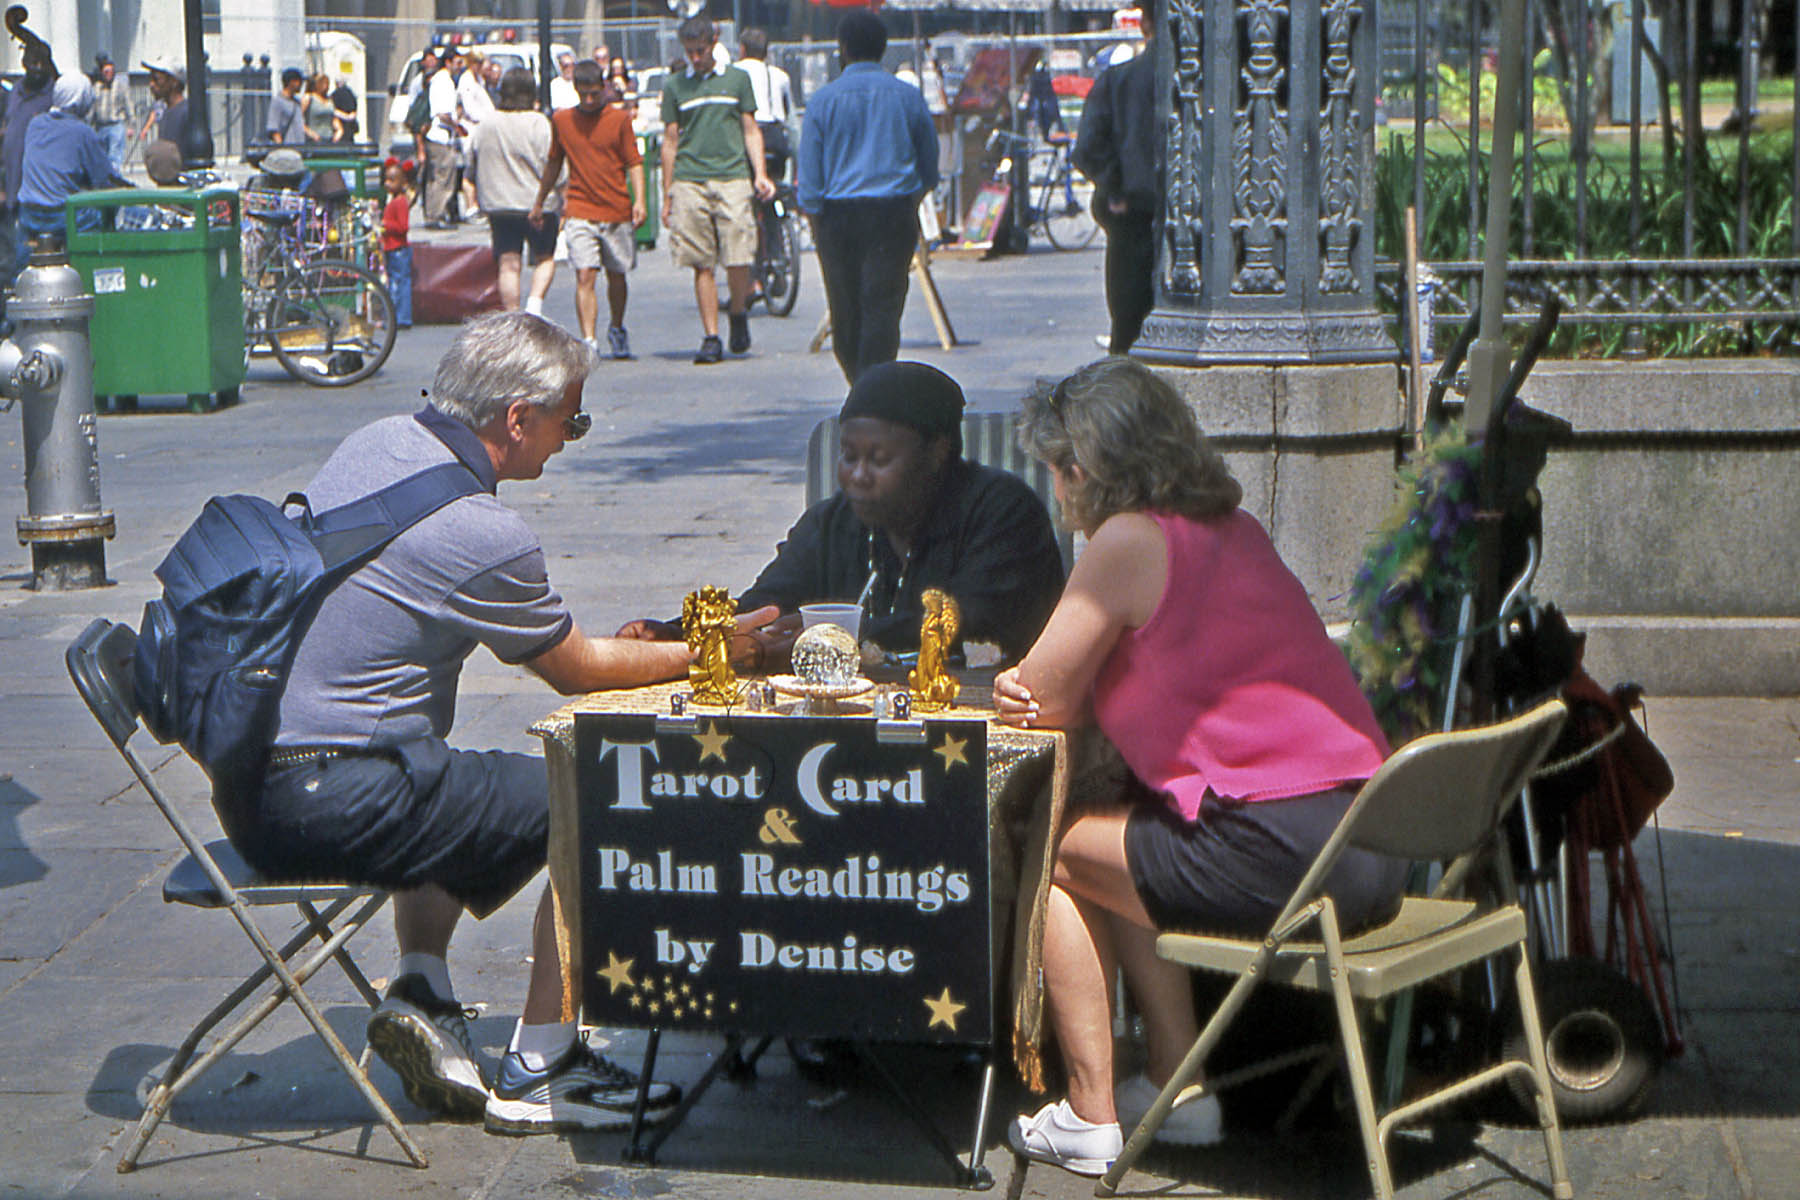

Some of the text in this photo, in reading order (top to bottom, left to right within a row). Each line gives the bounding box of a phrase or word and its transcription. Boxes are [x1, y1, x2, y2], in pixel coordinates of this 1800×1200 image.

[598, 738, 926, 816] Tarot Card
[759, 808, 801, 844] &
[598, 848, 971, 912] Palm Readings
[654, 929, 915, 973] by Denise
